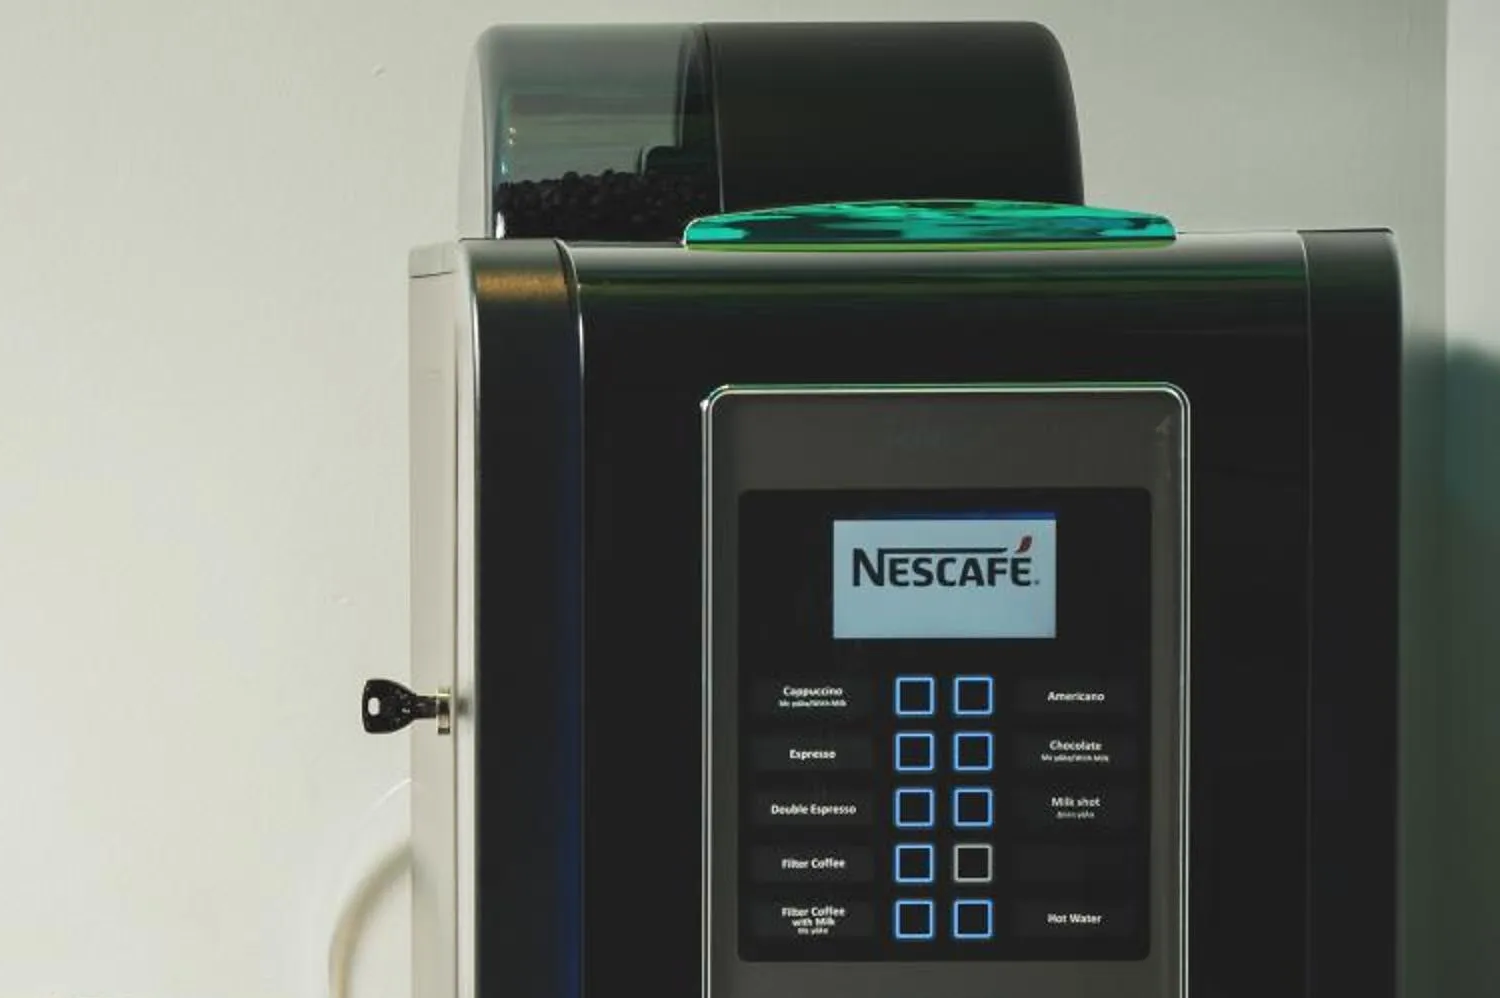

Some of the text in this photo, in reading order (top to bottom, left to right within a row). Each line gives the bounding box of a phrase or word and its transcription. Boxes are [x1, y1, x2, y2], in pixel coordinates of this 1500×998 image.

[852, 535, 1033, 587] NESCAFÉ
[783, 686, 843, 697] Cappuccino
[1047, 691, 1105, 701] Americano
[1049, 740, 1102, 750] Chocolate
[789, 749, 836, 760] Espresso
[1051, 797, 1101, 807] Milk shot
[771, 804, 857, 816] Double Espresso
[781, 858, 845, 869] Filter Coffee
[781, 906, 845, 917] Filter Coffee
[1047, 913, 1102, 924] Hot Water
